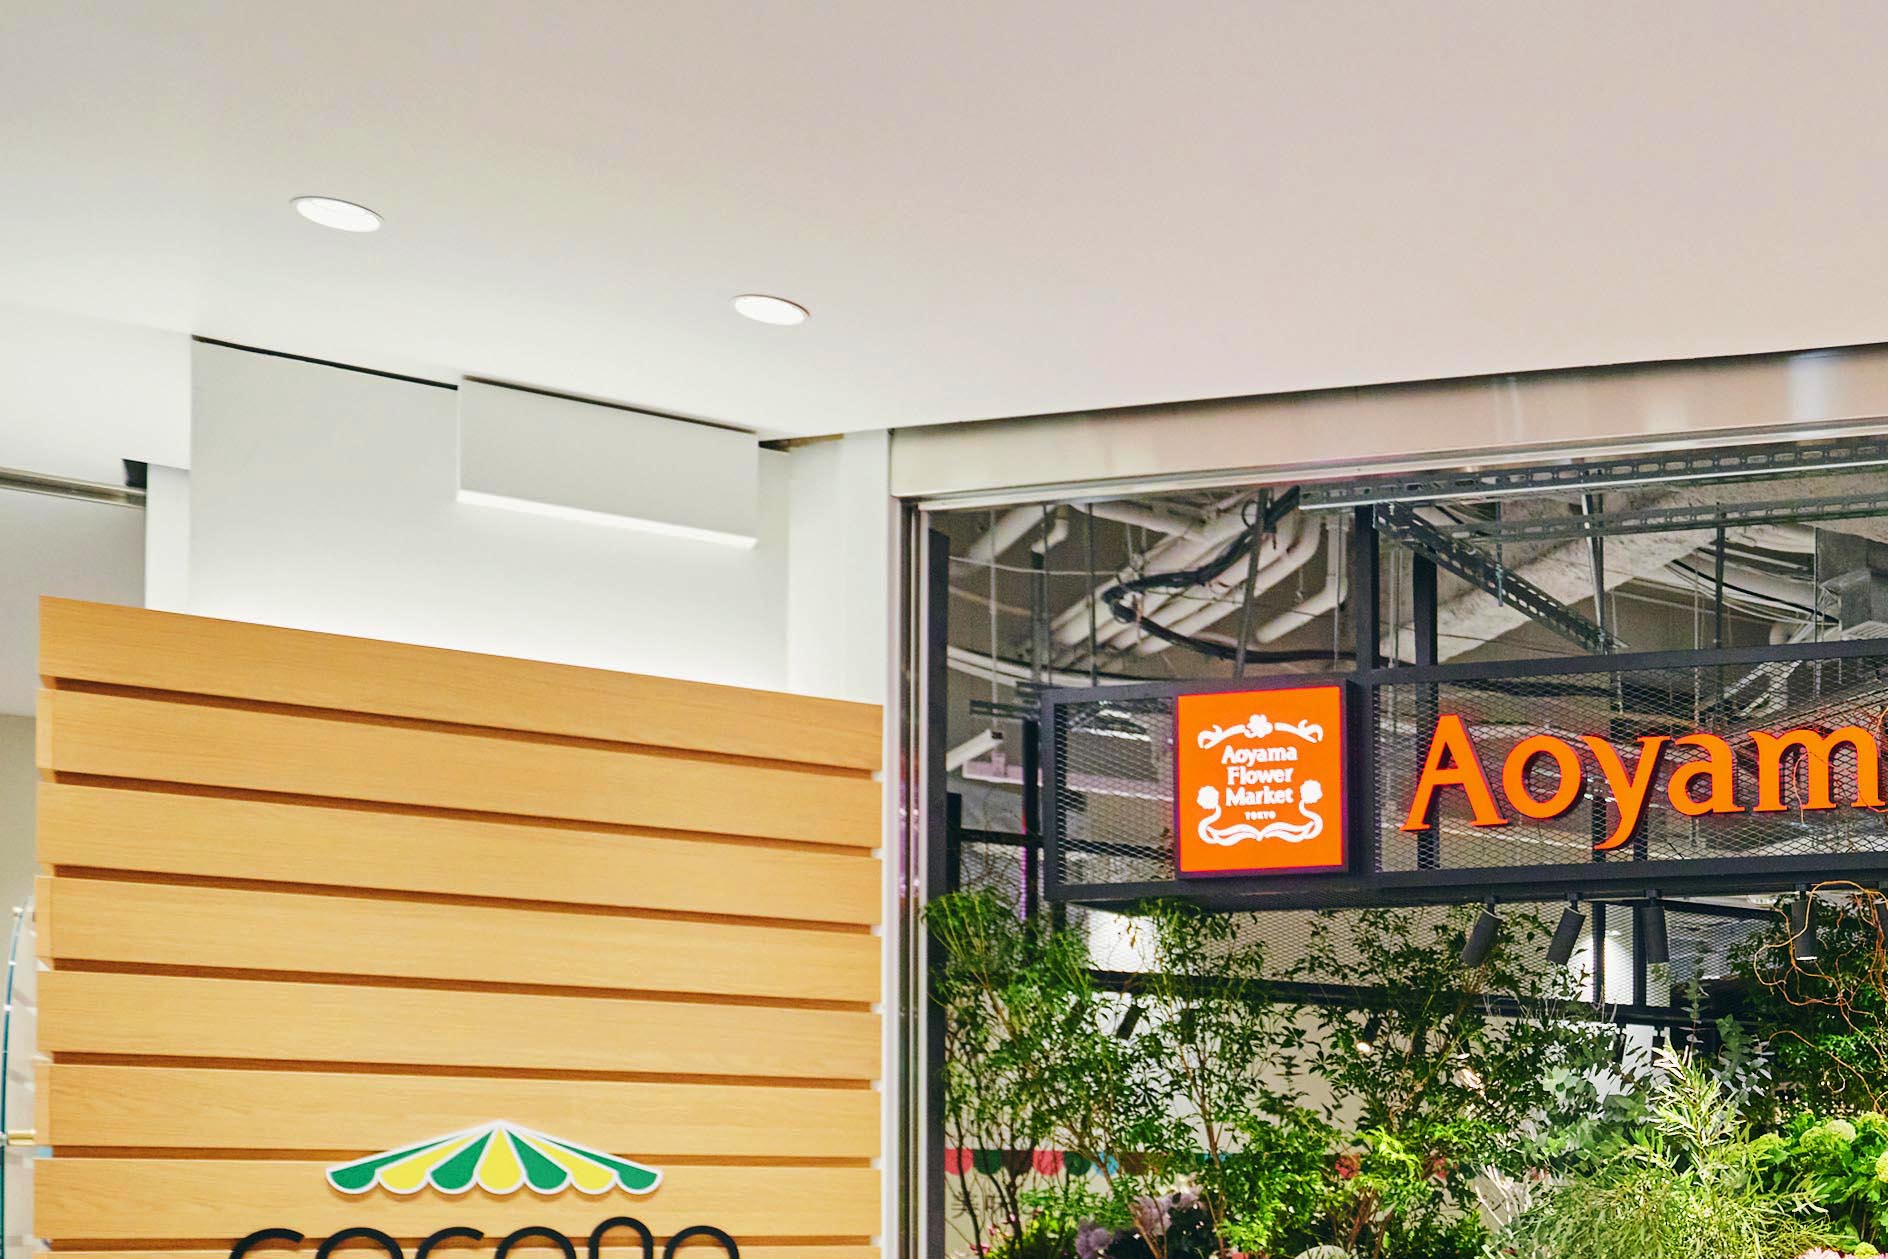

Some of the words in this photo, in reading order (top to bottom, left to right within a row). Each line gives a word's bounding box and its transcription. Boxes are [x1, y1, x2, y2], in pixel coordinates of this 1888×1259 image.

[1221, 745, 1298, 767] Aoyama
[1227, 766, 1294, 786] Flower
[1225, 786, 1294, 807] Market
[1244, 811, 1276, 820] TOKYO
